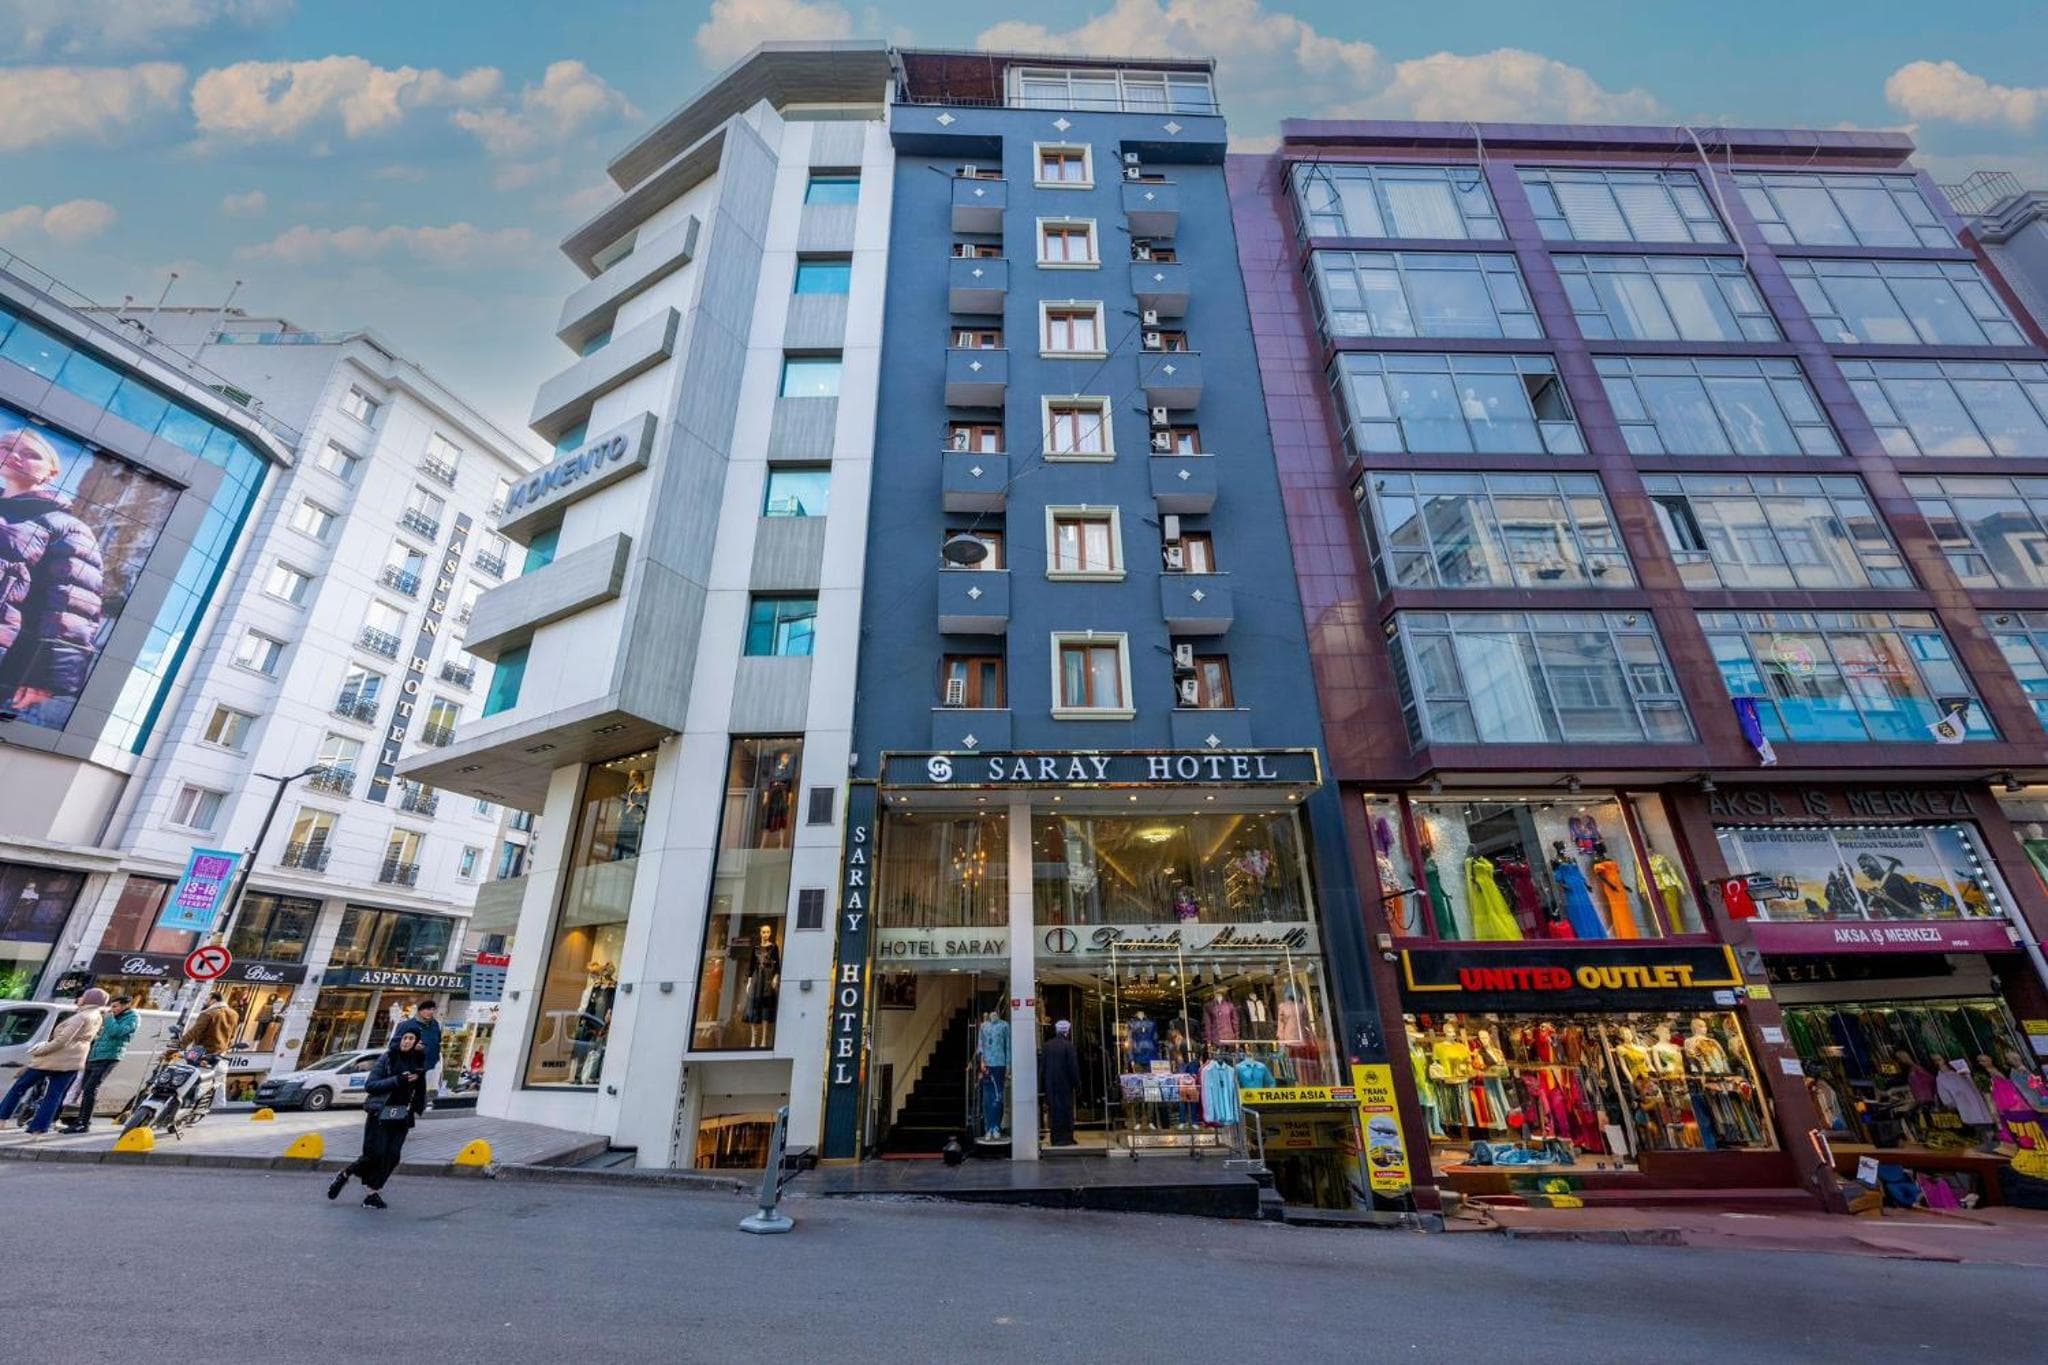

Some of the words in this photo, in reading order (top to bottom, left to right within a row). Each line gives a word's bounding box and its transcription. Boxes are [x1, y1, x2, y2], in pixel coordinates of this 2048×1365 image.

[506, 432, 628, 514] MOMENTO
[422, 541, 464, 637] ASPEN
[380, 655, 429, 767] HOTEL
[989, 756, 1111, 780] SARAY
[1147, 755, 1278, 780] HOTEL
[1710, 791, 1786, 816] AKSA
[1769, 832, 1828, 842] DETECTORS
[847, 826, 867, 932] SARAY
[1834, 928, 1870, 942] AKSA
[880, 940, 940, 956] HOTEL
[945, 940, 1005, 954] SARAY
[360, 971, 412, 985] ASPEN
[414, 974, 464, 988] HOTEL
[1459, 967, 1573, 991] UNITED
[1576, 965, 1695, 989] OUTLET
[835, 964, 860, 1085] HOTEL
[1259, 1091, 1297, 1101] TRANS
[1299, 1090, 1326, 1100] ASIA
[1363, 1087, 1388, 1096] TRANS
[1368, 1096, 1387, 1104] ASIA
